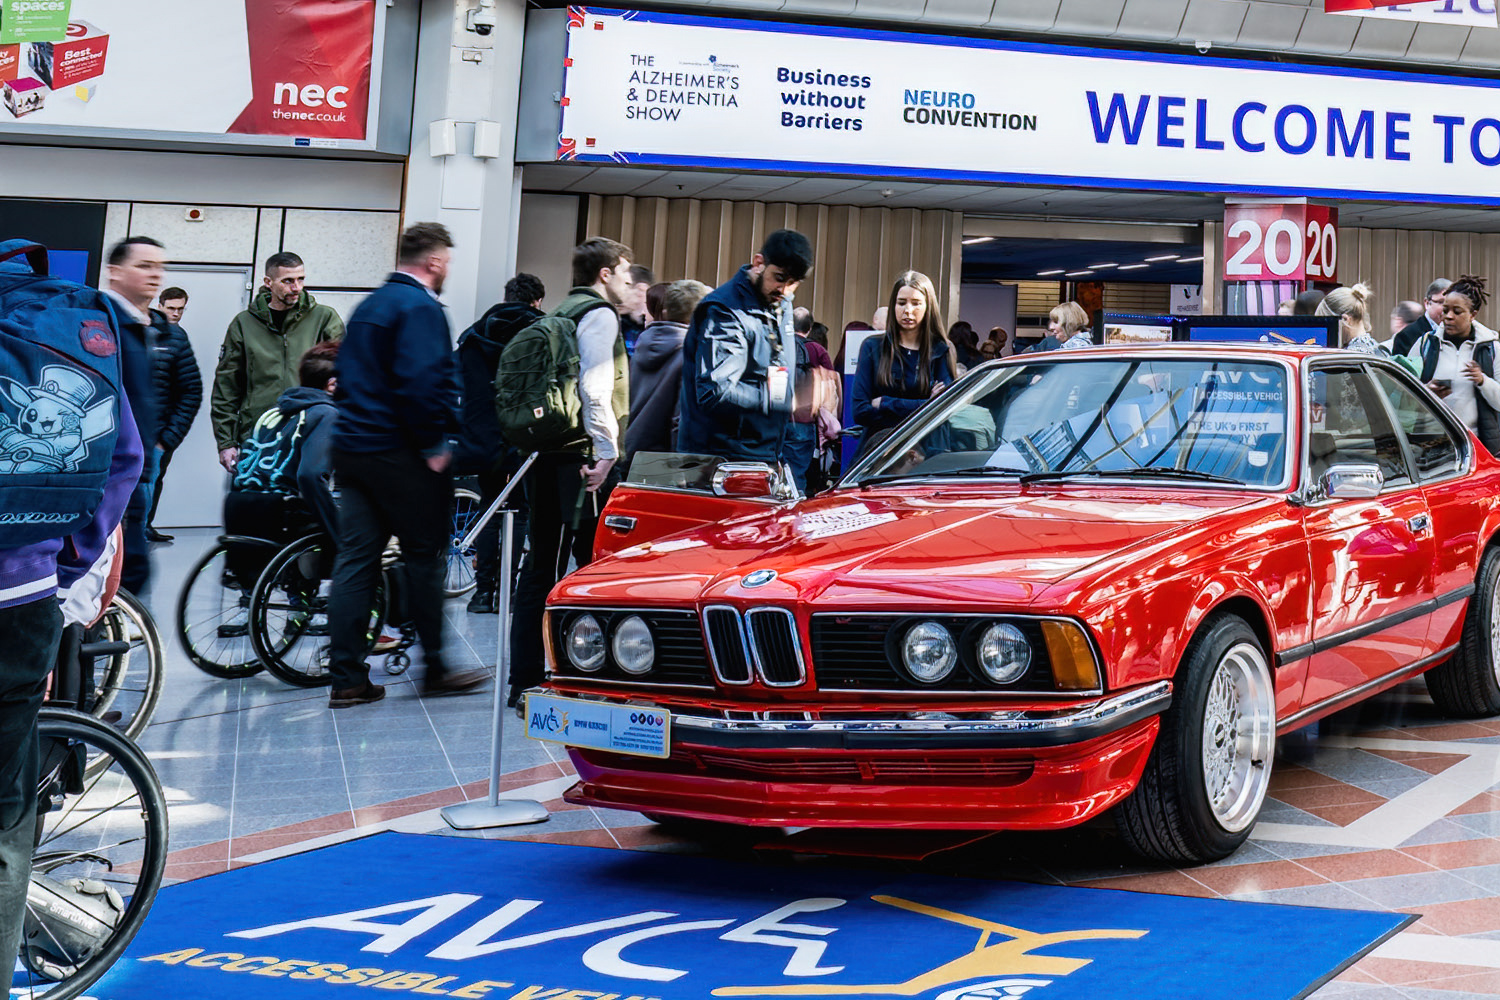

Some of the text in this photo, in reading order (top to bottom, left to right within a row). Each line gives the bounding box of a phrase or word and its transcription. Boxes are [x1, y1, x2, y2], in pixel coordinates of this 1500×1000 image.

[11, 0, 66, 14] spaces
[59, 51, 103, 67] connected
[64, 47, 92, 61] Best
[630, 54, 655, 67] THE
[629, 70, 740, 90] ALZHEIMER'S
[777, 67, 872, 89] Business
[273, 82, 350, 109] nec
[627, 88, 739, 108] & DEMENTIA
[781, 90, 866, 110] without
[904, 89, 976, 110] NEURO
[272, 108, 347, 123] thenec.co.uk
[626, 105, 681, 121] SHOW
[781, 111, 863, 131] Barriers
[903, 107, 1038, 132] CONVENTION
[1085, 90, 1411, 161] WELCOME
[1225, 219, 1302, 277] 20
[1305, 220, 1338, 279] 20
[136, 947, 515, 999] ACCESSIBLE
